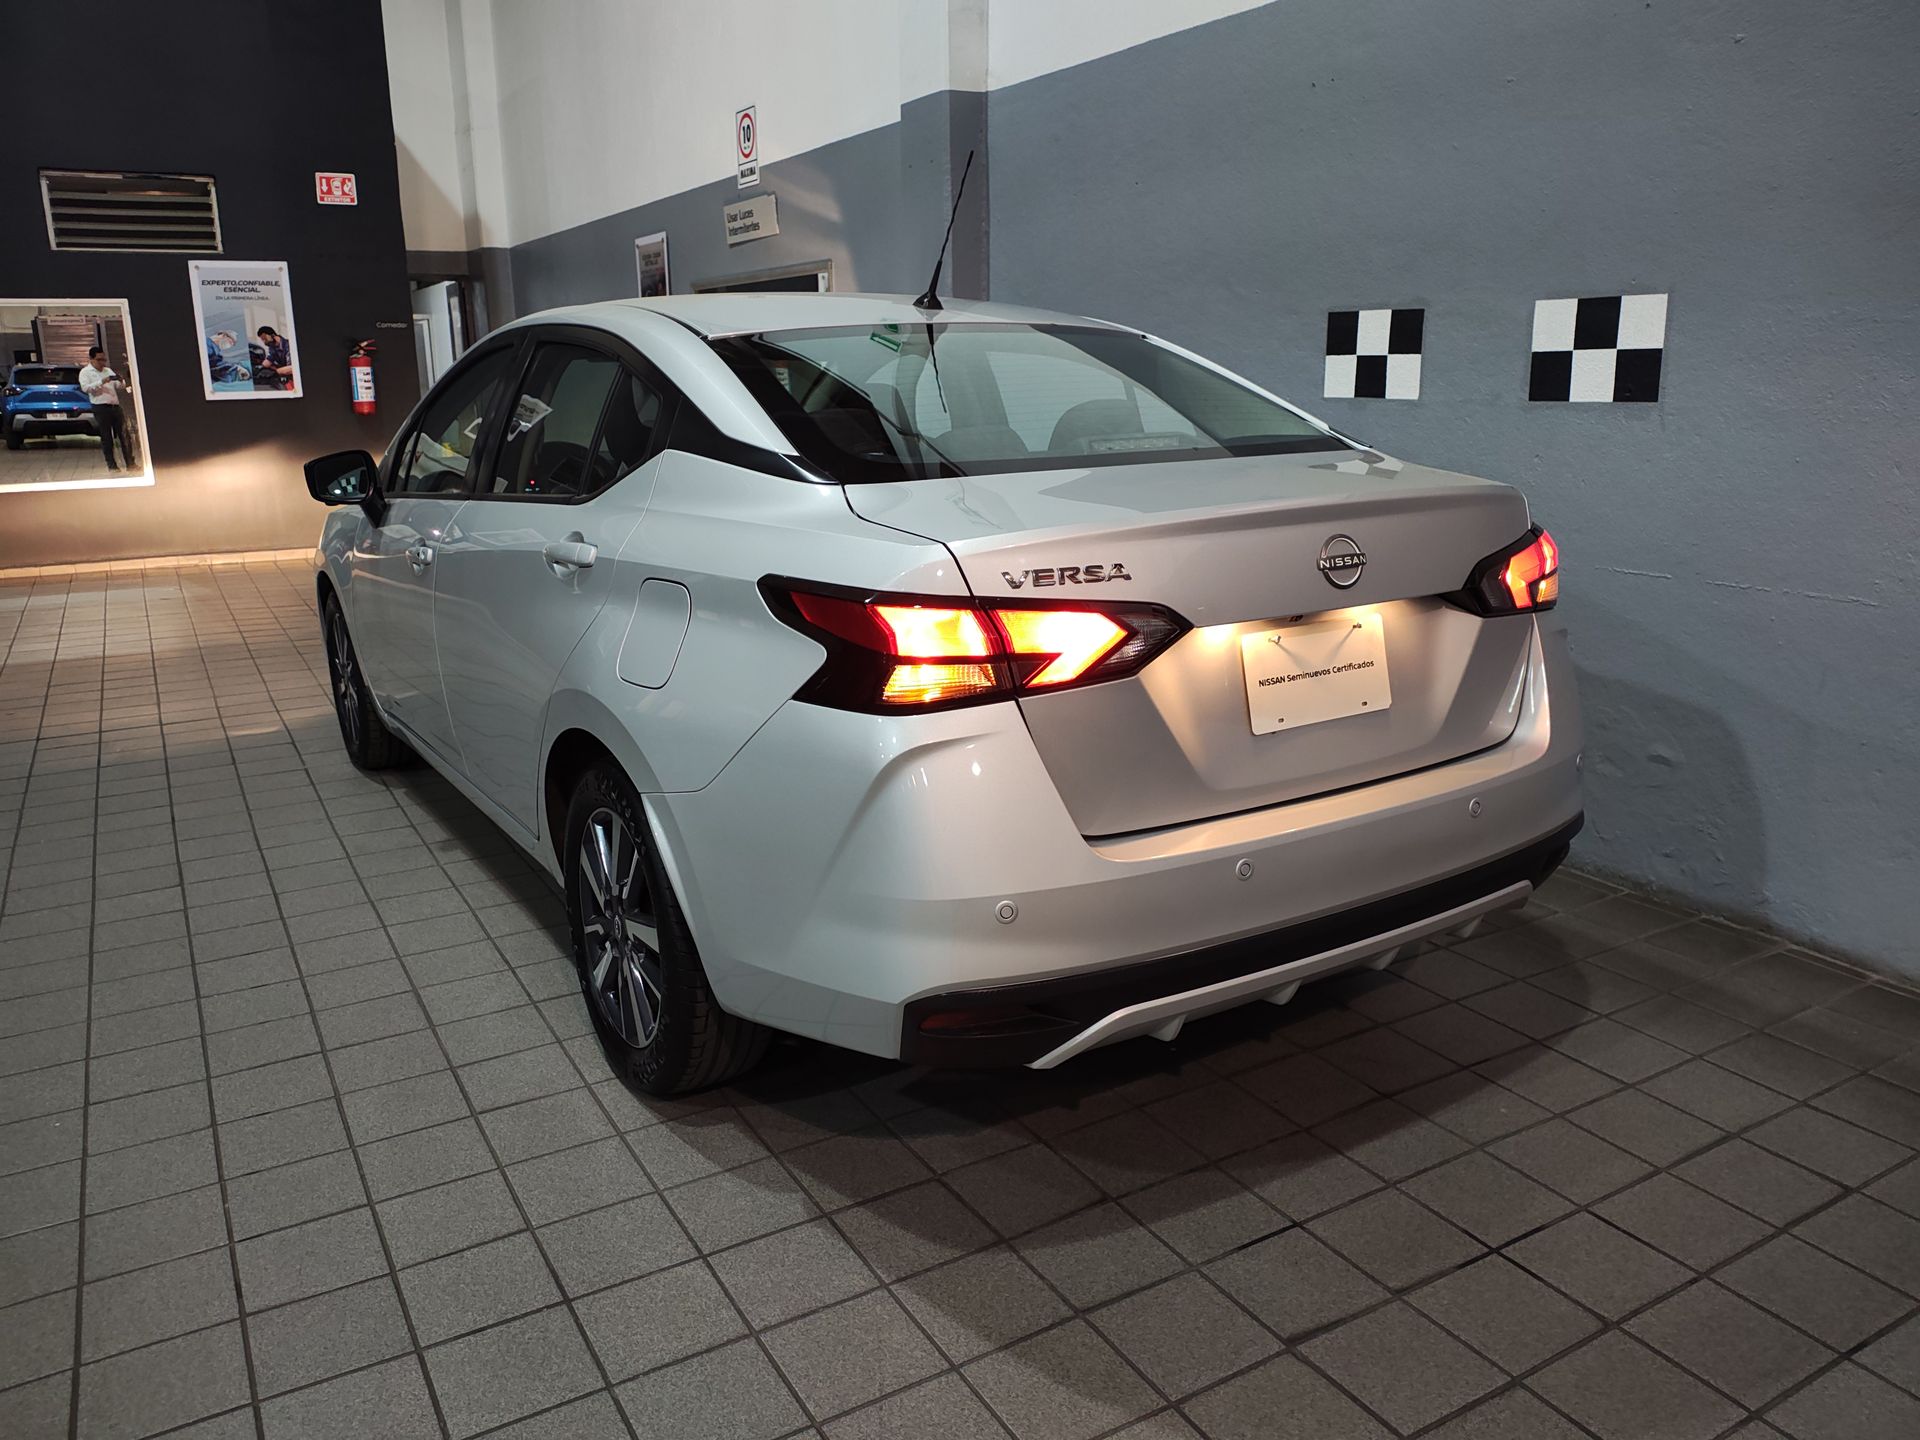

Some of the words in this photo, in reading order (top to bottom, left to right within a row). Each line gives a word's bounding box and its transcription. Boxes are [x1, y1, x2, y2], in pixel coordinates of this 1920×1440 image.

[742, 124, 751, 144] 10
[739, 209, 754, 220] Luces
[1320, 555, 1366, 568] NISSAN
[1001, 563, 1132, 589] VERSA
[1258, 675, 1286, 687] NISSAN
[1286, 668, 1331, 682] Seminuevos
[1332, 660, 1375, 673] Certificados
